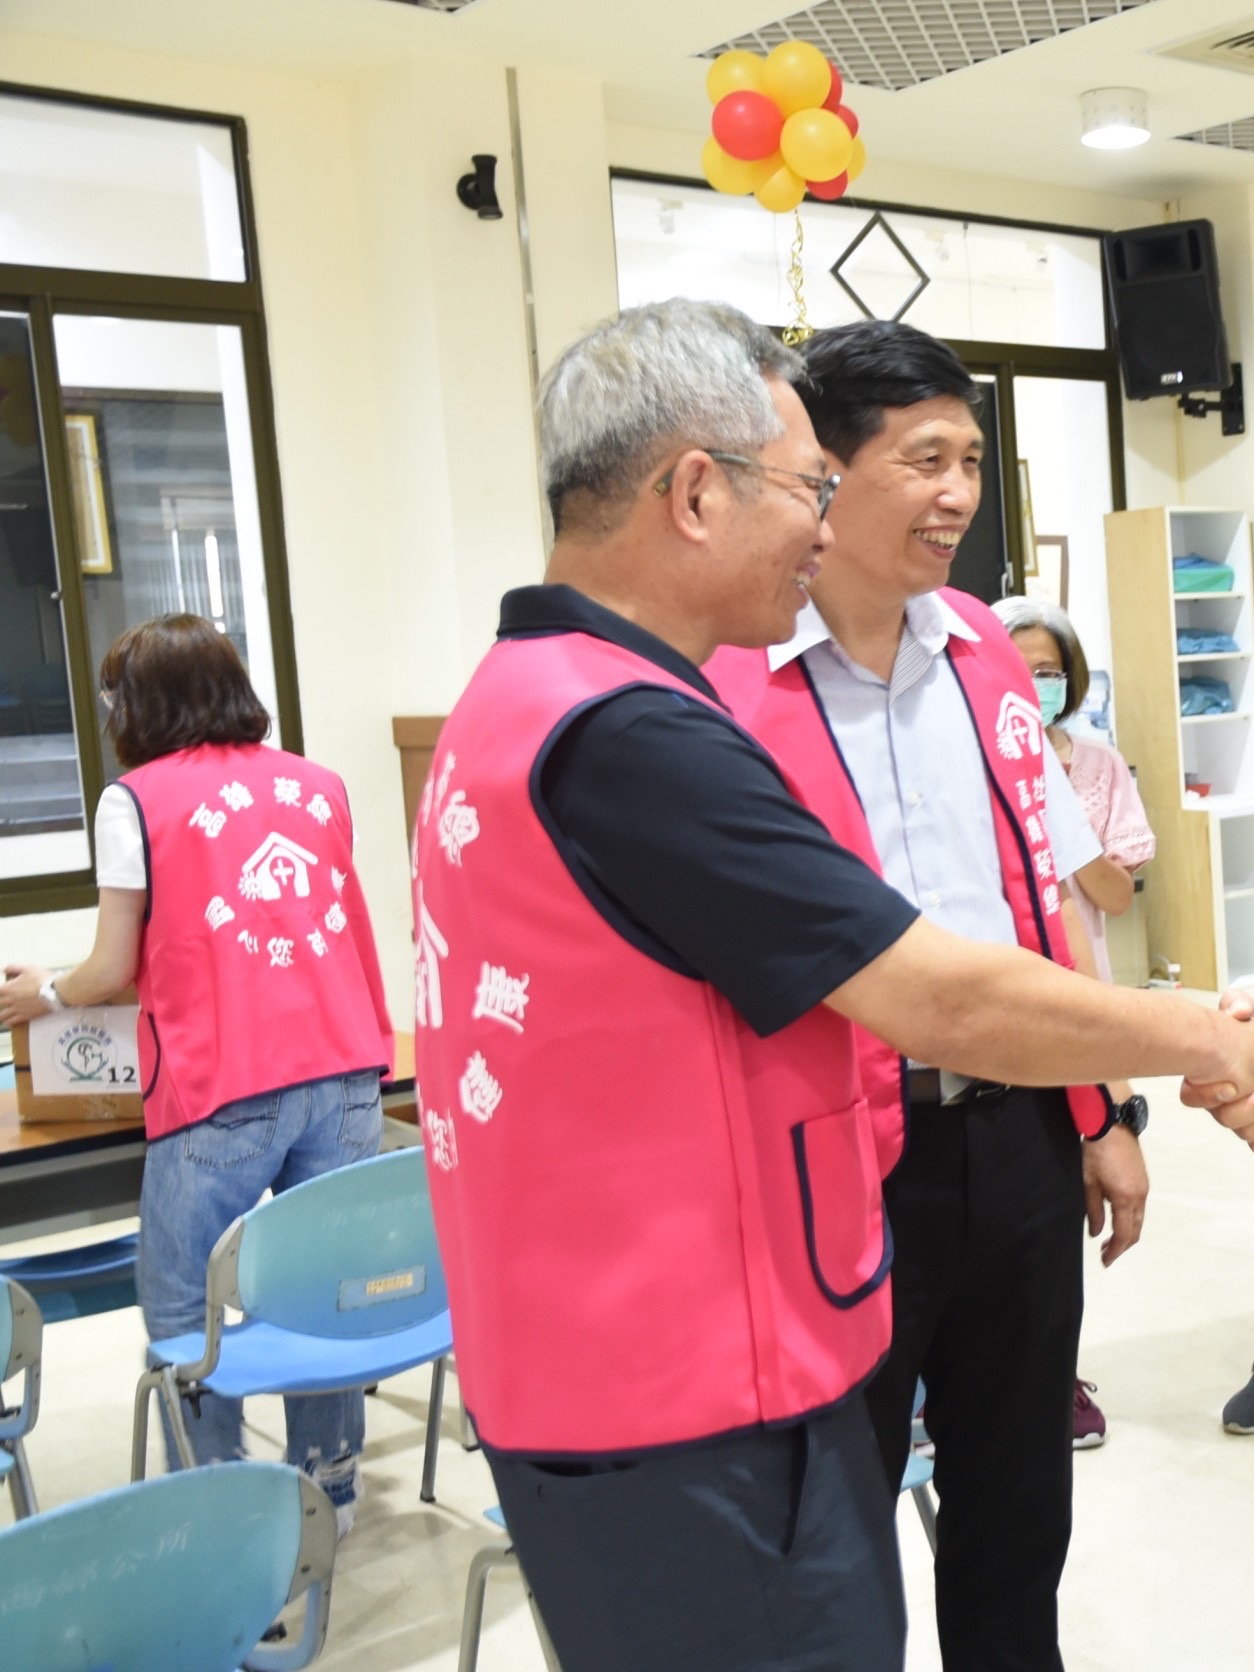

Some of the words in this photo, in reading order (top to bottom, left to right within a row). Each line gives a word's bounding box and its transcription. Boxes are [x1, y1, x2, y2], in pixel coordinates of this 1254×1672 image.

[188, 776, 333, 838] 高雄榮總
[107, 1065, 137, 1084] 12
